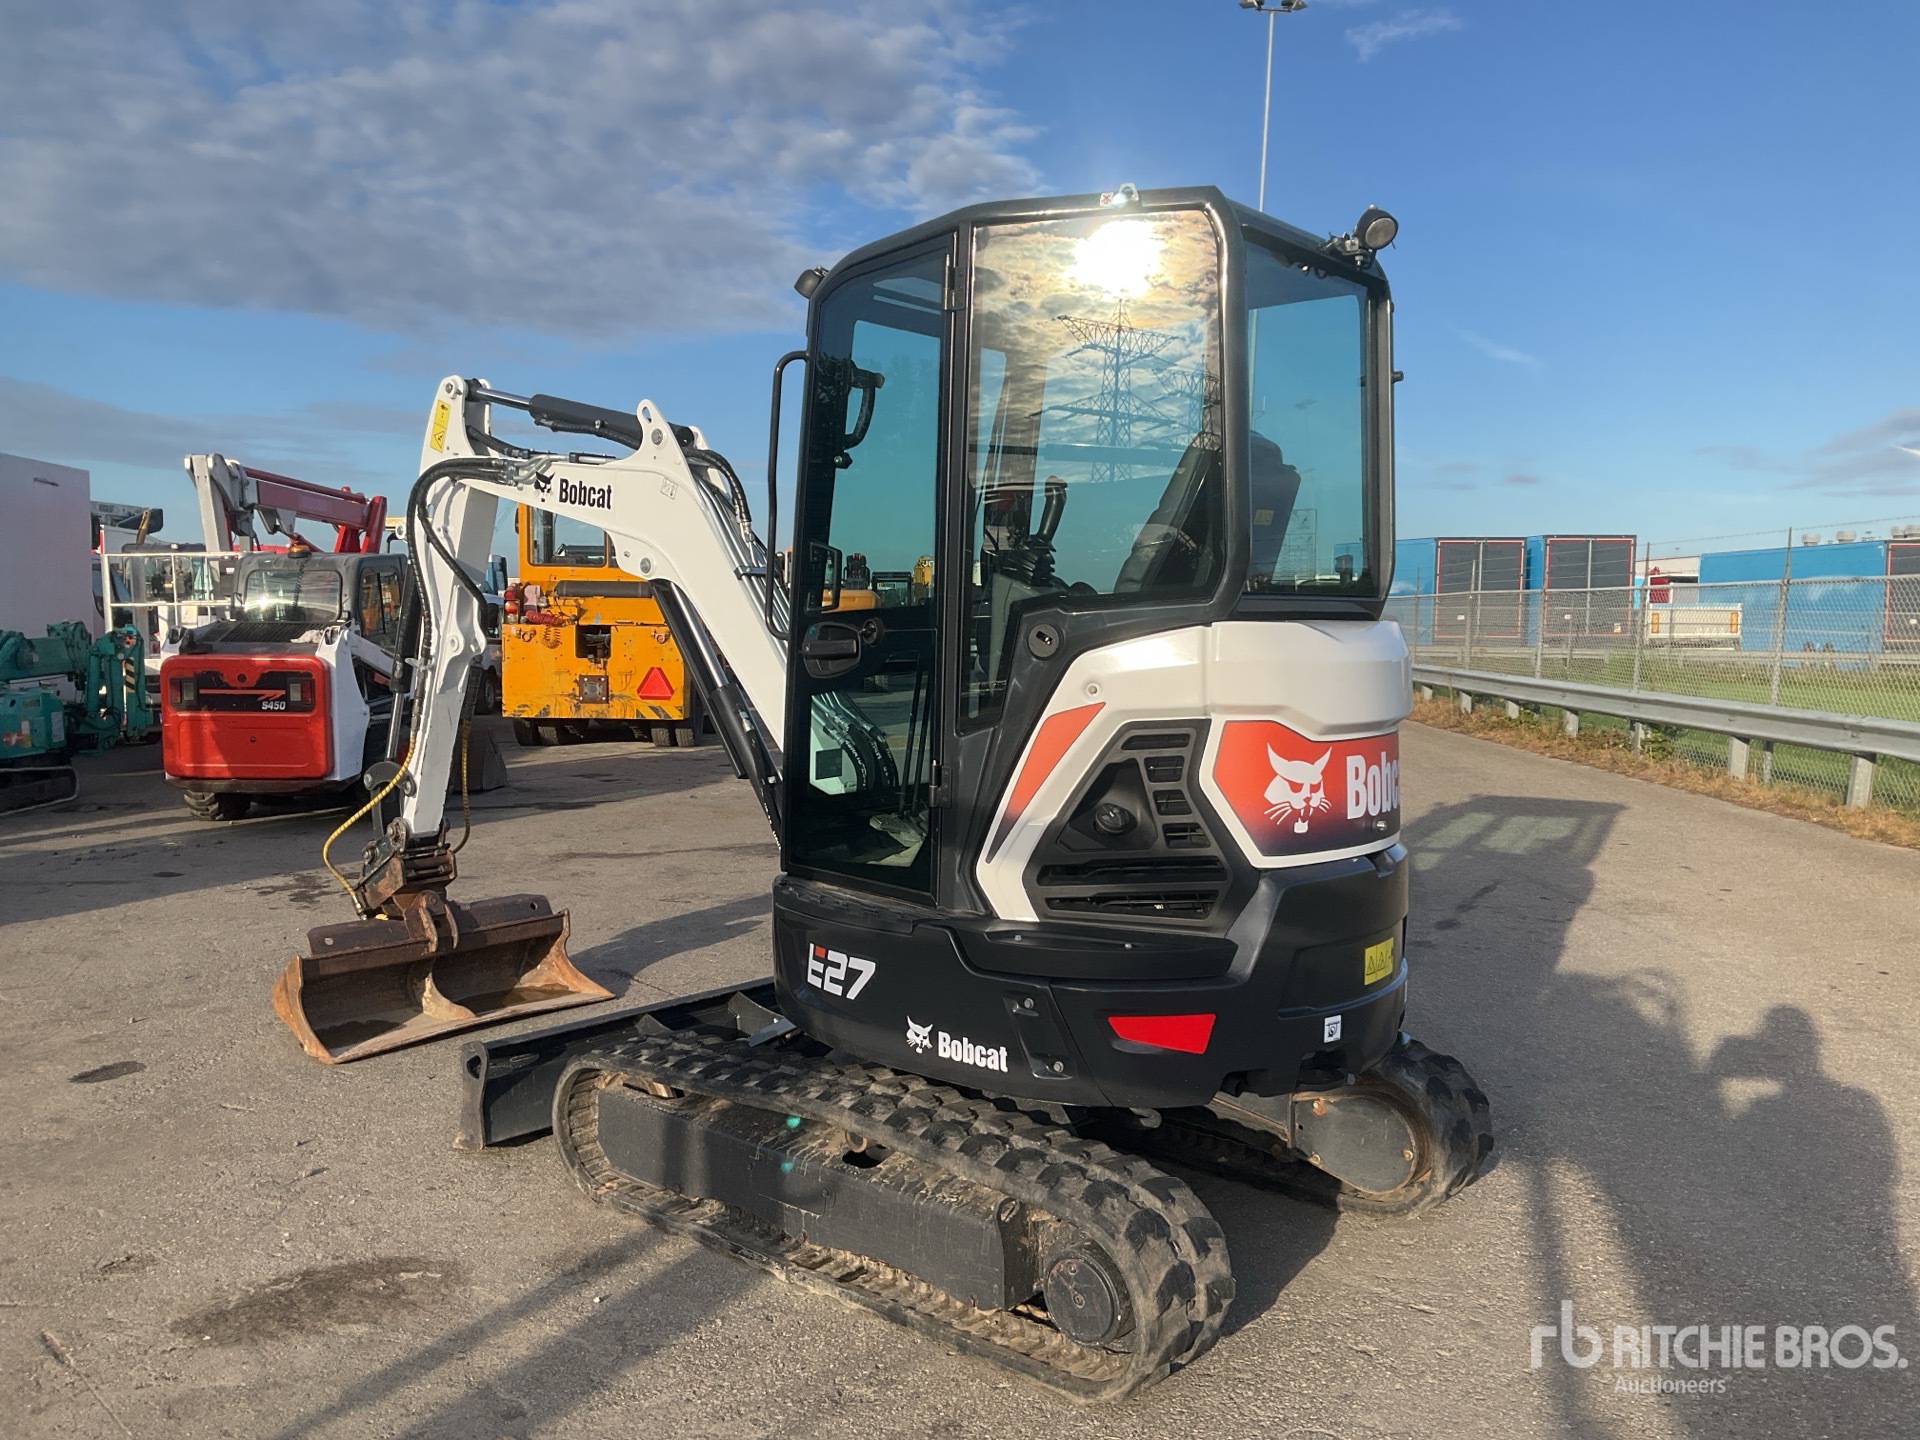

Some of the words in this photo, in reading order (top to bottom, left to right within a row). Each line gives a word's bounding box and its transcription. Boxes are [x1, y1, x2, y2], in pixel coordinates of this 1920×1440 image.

[558, 478, 612, 510] Bobcat
[261, 701, 286, 710] S450
[1346, 751, 1399, 819] Bobc
[807, 942, 876, 1000] E27
[938, 1030, 1008, 1073] Bobcat
